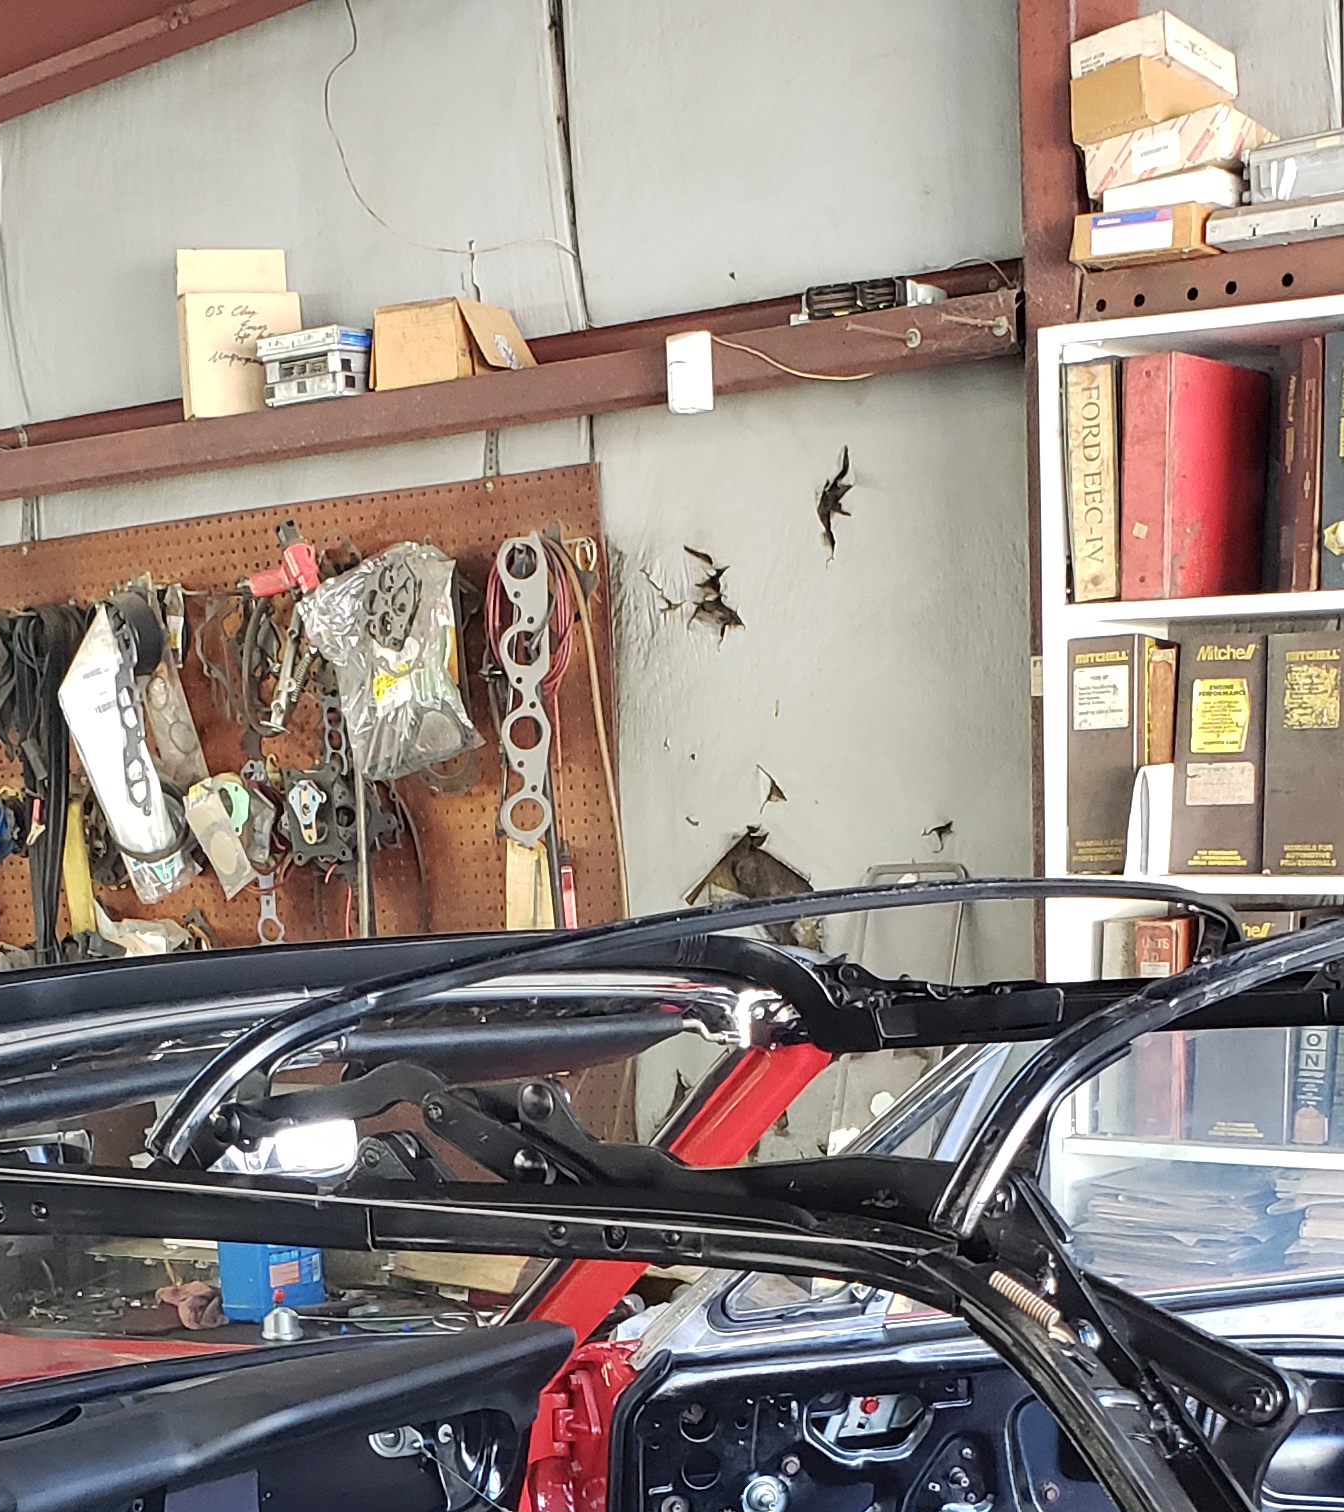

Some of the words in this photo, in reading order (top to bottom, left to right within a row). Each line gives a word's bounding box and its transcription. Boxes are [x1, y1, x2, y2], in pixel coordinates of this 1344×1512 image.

[1081, 386, 1101, 463] FORD
[1083, 472, 1104, 563] EEC-IV
[1076, 650, 1128, 664] MITCHELL
[1196, 644, 1256, 662] Mitchell
[1286, 649, 1341, 661] MITCHELL
[1241, 922, 1272, 938] hell
